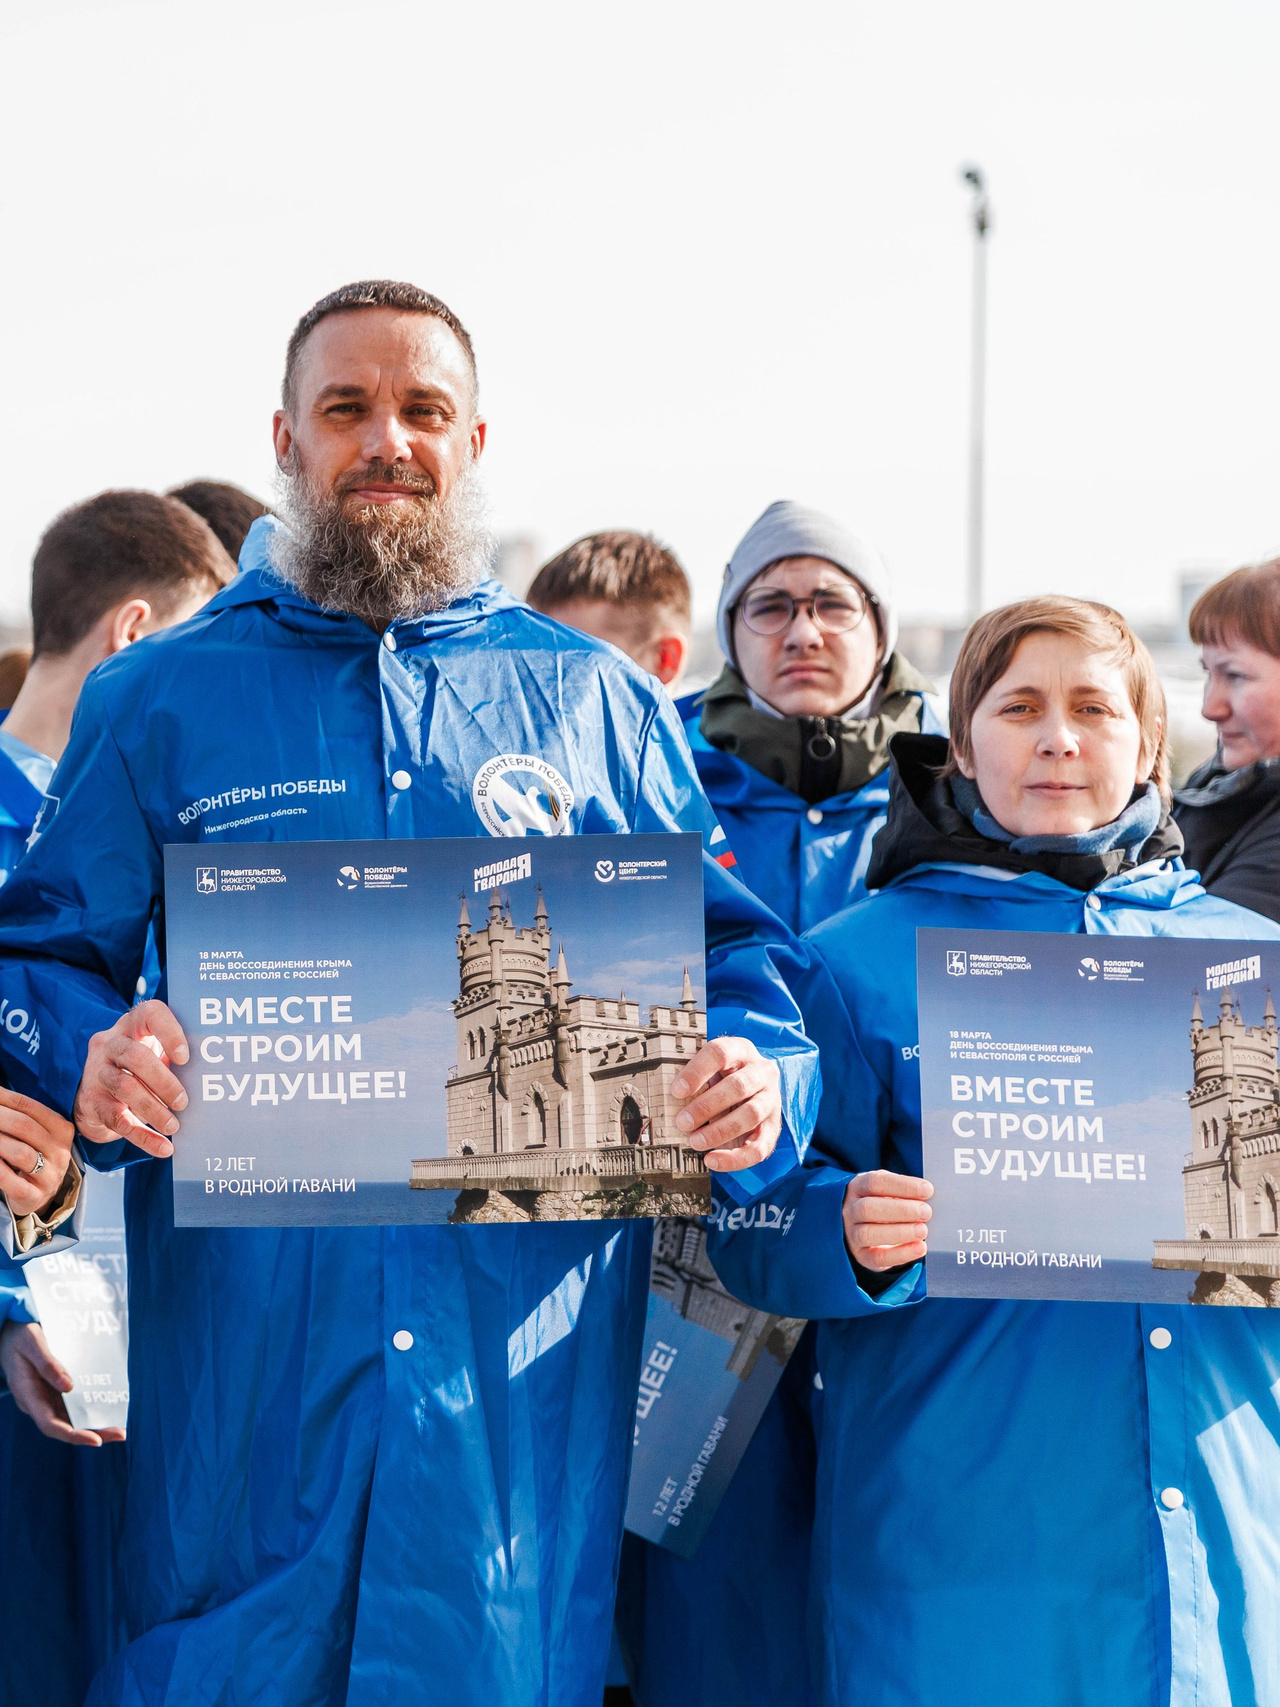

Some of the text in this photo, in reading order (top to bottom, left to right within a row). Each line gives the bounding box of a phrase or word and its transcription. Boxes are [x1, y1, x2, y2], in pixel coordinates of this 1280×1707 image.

[478, 756, 534, 797] ВОЛОНТЁРЫ
[178, 779, 346, 825] ВОЛОНТЁРЫ ПОБЕДЫ
[205, 808, 307, 835] Нижегородская область
[364, 866, 407, 874] ВОЛОНТЁРЫ
[474, 853, 531, 880] МОЛОДАЯ
[221, 875, 286, 884] НИЖЕГОРОДСКОЙ
[211, 951, 244, 959] МАРТА
[970, 954, 1026, 963] ПРАВИТЕЛЬСТВО
[199, 960, 352, 971] ДЕНЬ ВОССОЕДИНЕНИЯ КРЫМА
[209, 972, 281, 980] СЕВАСТОПОЛЯ
[283, 971, 290, 979] С
[293, 969, 339, 979] РОССИЕЙ
[970, 962, 1031, 970] НИЖЕГОРОДСКОЙ
[970, 968, 1003, 976] ОБЛАСТИ
[1206, 955, 1261, 980] МОЛОДАЯ
[200, 995, 353, 1025] ВМЕСТЕ
[961, 1031, 992, 1039] МАРТА
[200, 1033, 361, 1063] СТРОИМ
[950, 1041, 1093, 1054] ДЕНЬ ВОССОЕДИНЕНИЯ КРЫМА
[959, 1051, 1027, 1061] СЕВАСТОПОЛЯ
[1038, 1054, 1081, 1063] РОССИЕЙ
[202, 1071, 406, 1106] БУДУЩЕЕ!
[951, 1075, 1094, 1106] ВМЕСТЕ
[952, 1111, 1104, 1143] СТРОИМ
[205, 1157, 256, 1171] 12 ЛЕТ
[954, 1148, 1146, 1184] БУДУЩЕЕ!
[205, 1176, 356, 1196] В РОДНОЙ ГАВАНИ
[957, 1229, 1007, 1243] 12 ЛЕТ
[956, 1249, 1102, 1269] В РОДНОЙ ГАВАНИ
[633, 1340, 678, 1446] ЩЕЕ!
[667, 1415, 729, 1527] В РОДНОЙ ГАВАНИ
[660, 1476, 678, 1503] ЛЕТ
